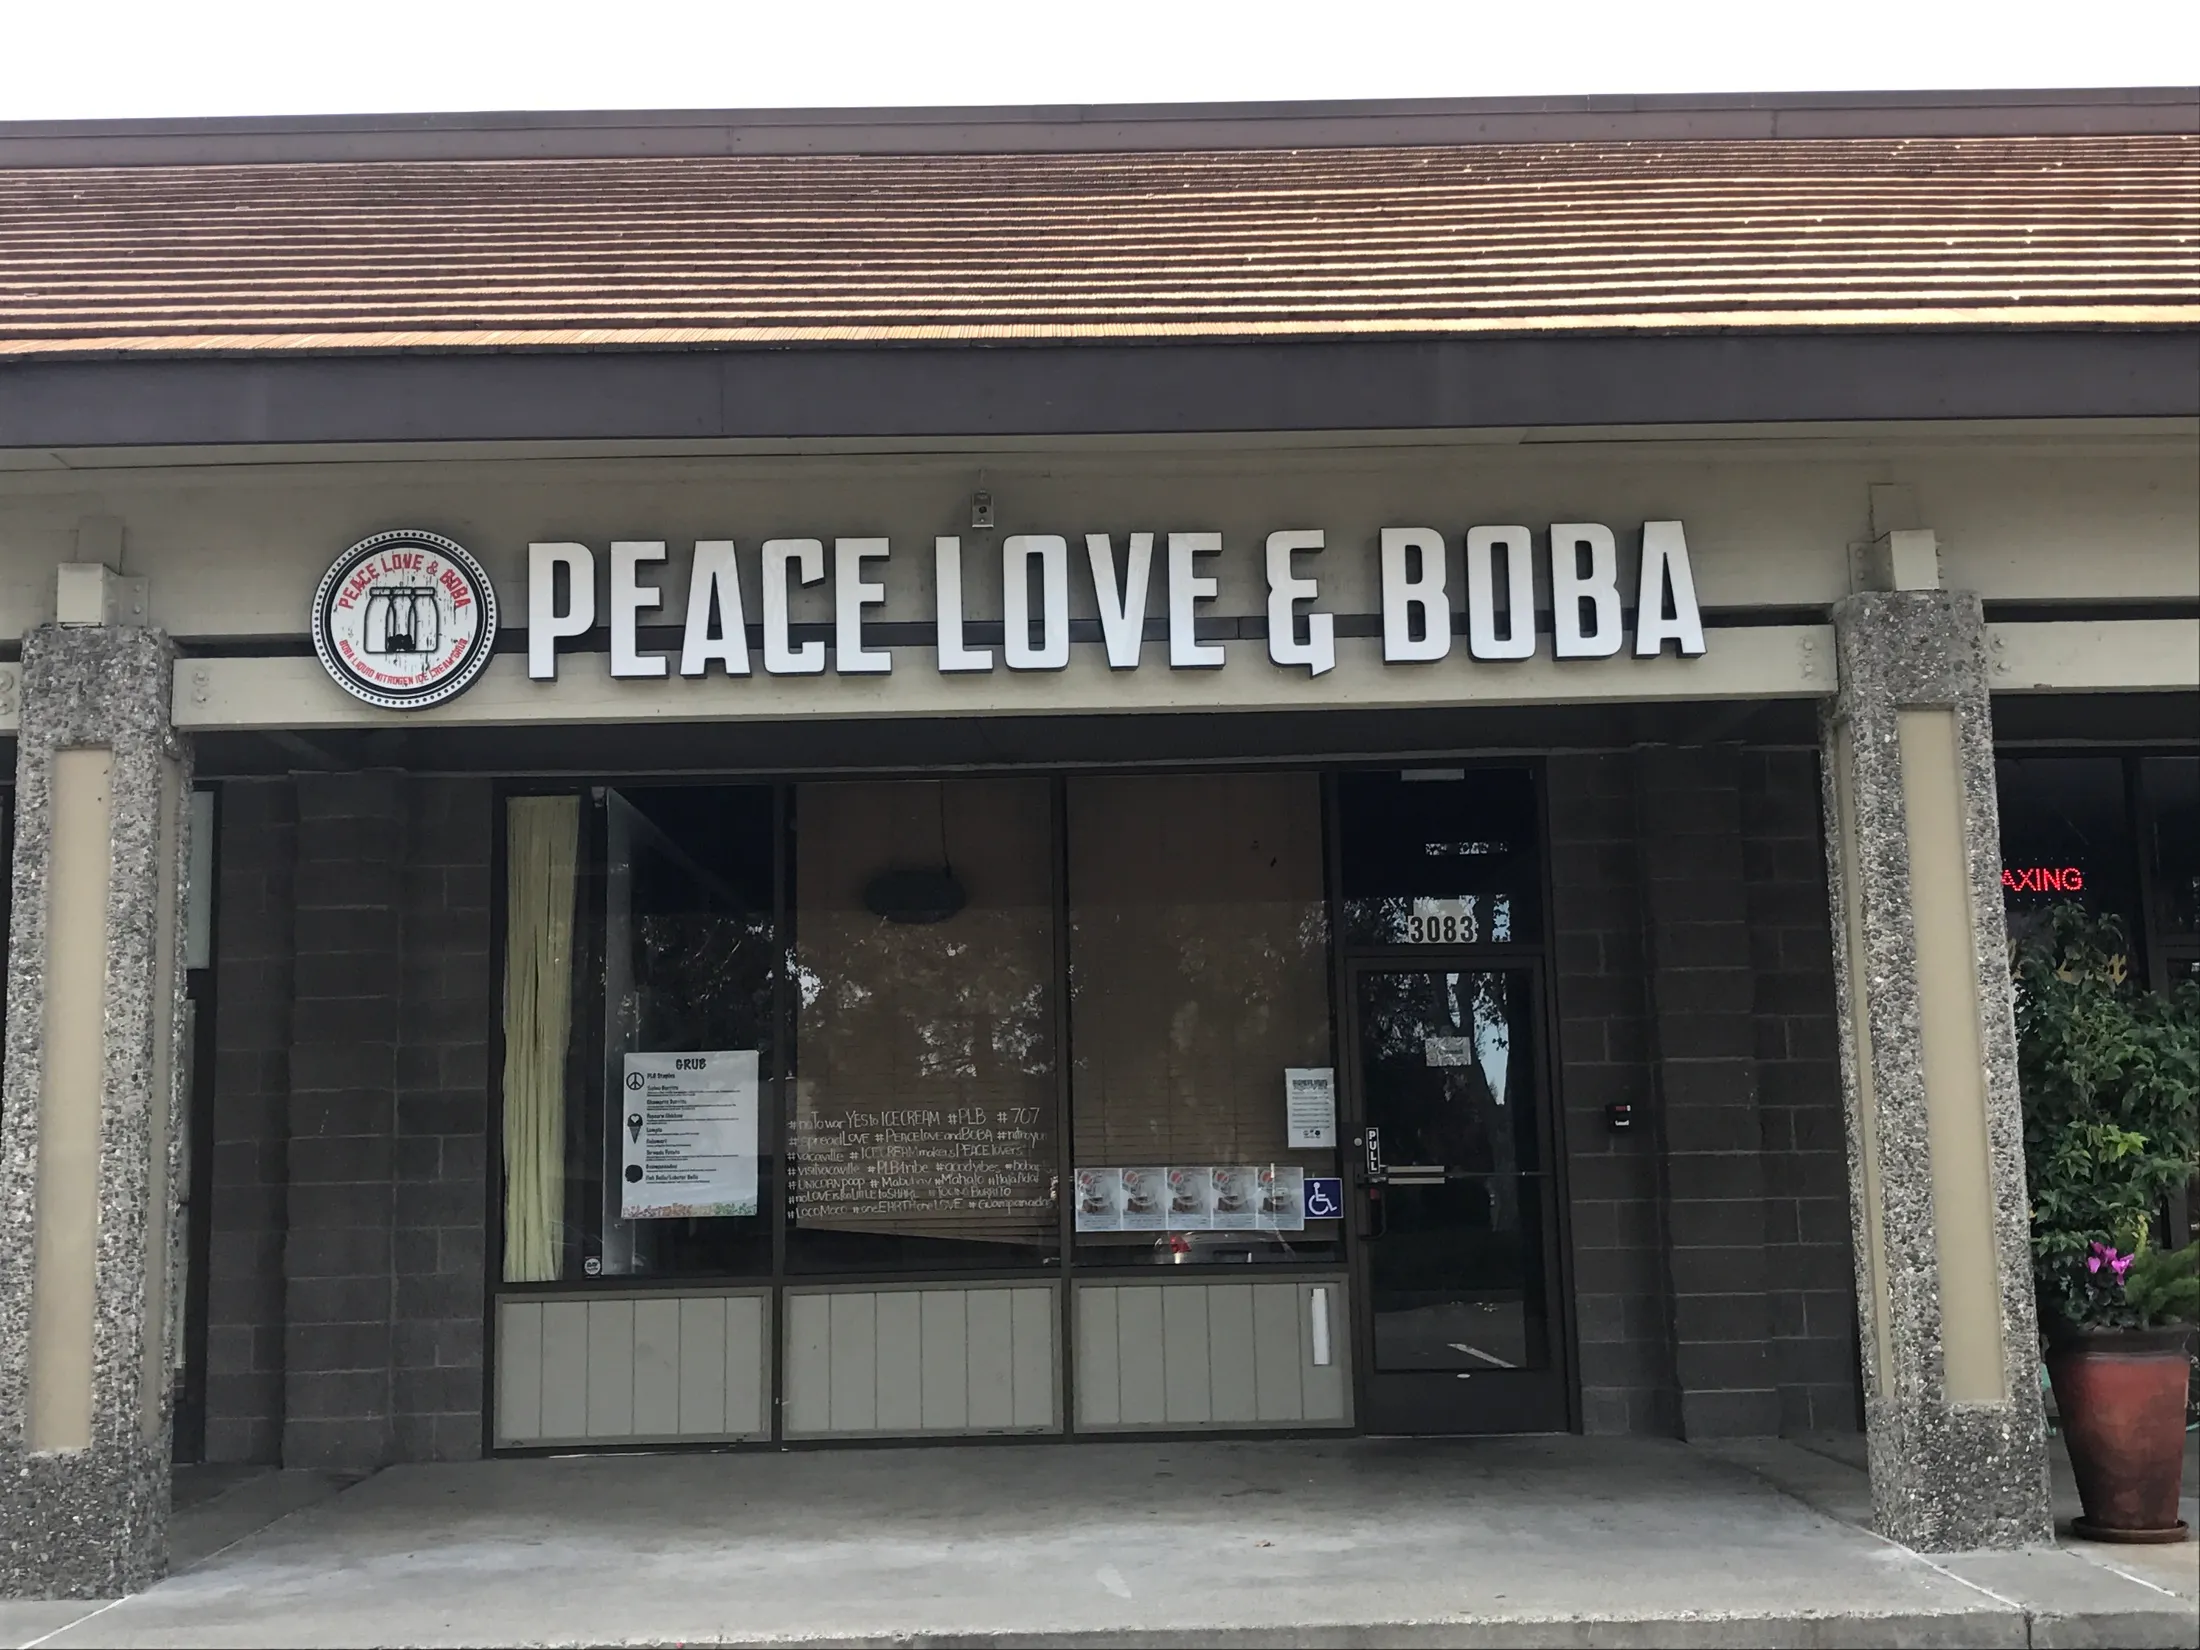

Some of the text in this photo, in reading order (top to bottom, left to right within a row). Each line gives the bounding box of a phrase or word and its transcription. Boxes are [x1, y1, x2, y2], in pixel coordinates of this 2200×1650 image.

[338, 554, 471, 609] PEACE LOVE & BOBA
[528, 520, 1706, 680] PEACE LOVE & BOBA
[1410, 916, 1474, 943] 3083
[675, 1057, 707, 1070] GRUB
[947, 1108, 986, 1125] #PLB
[1368, 1130, 1378, 1172] PULL
